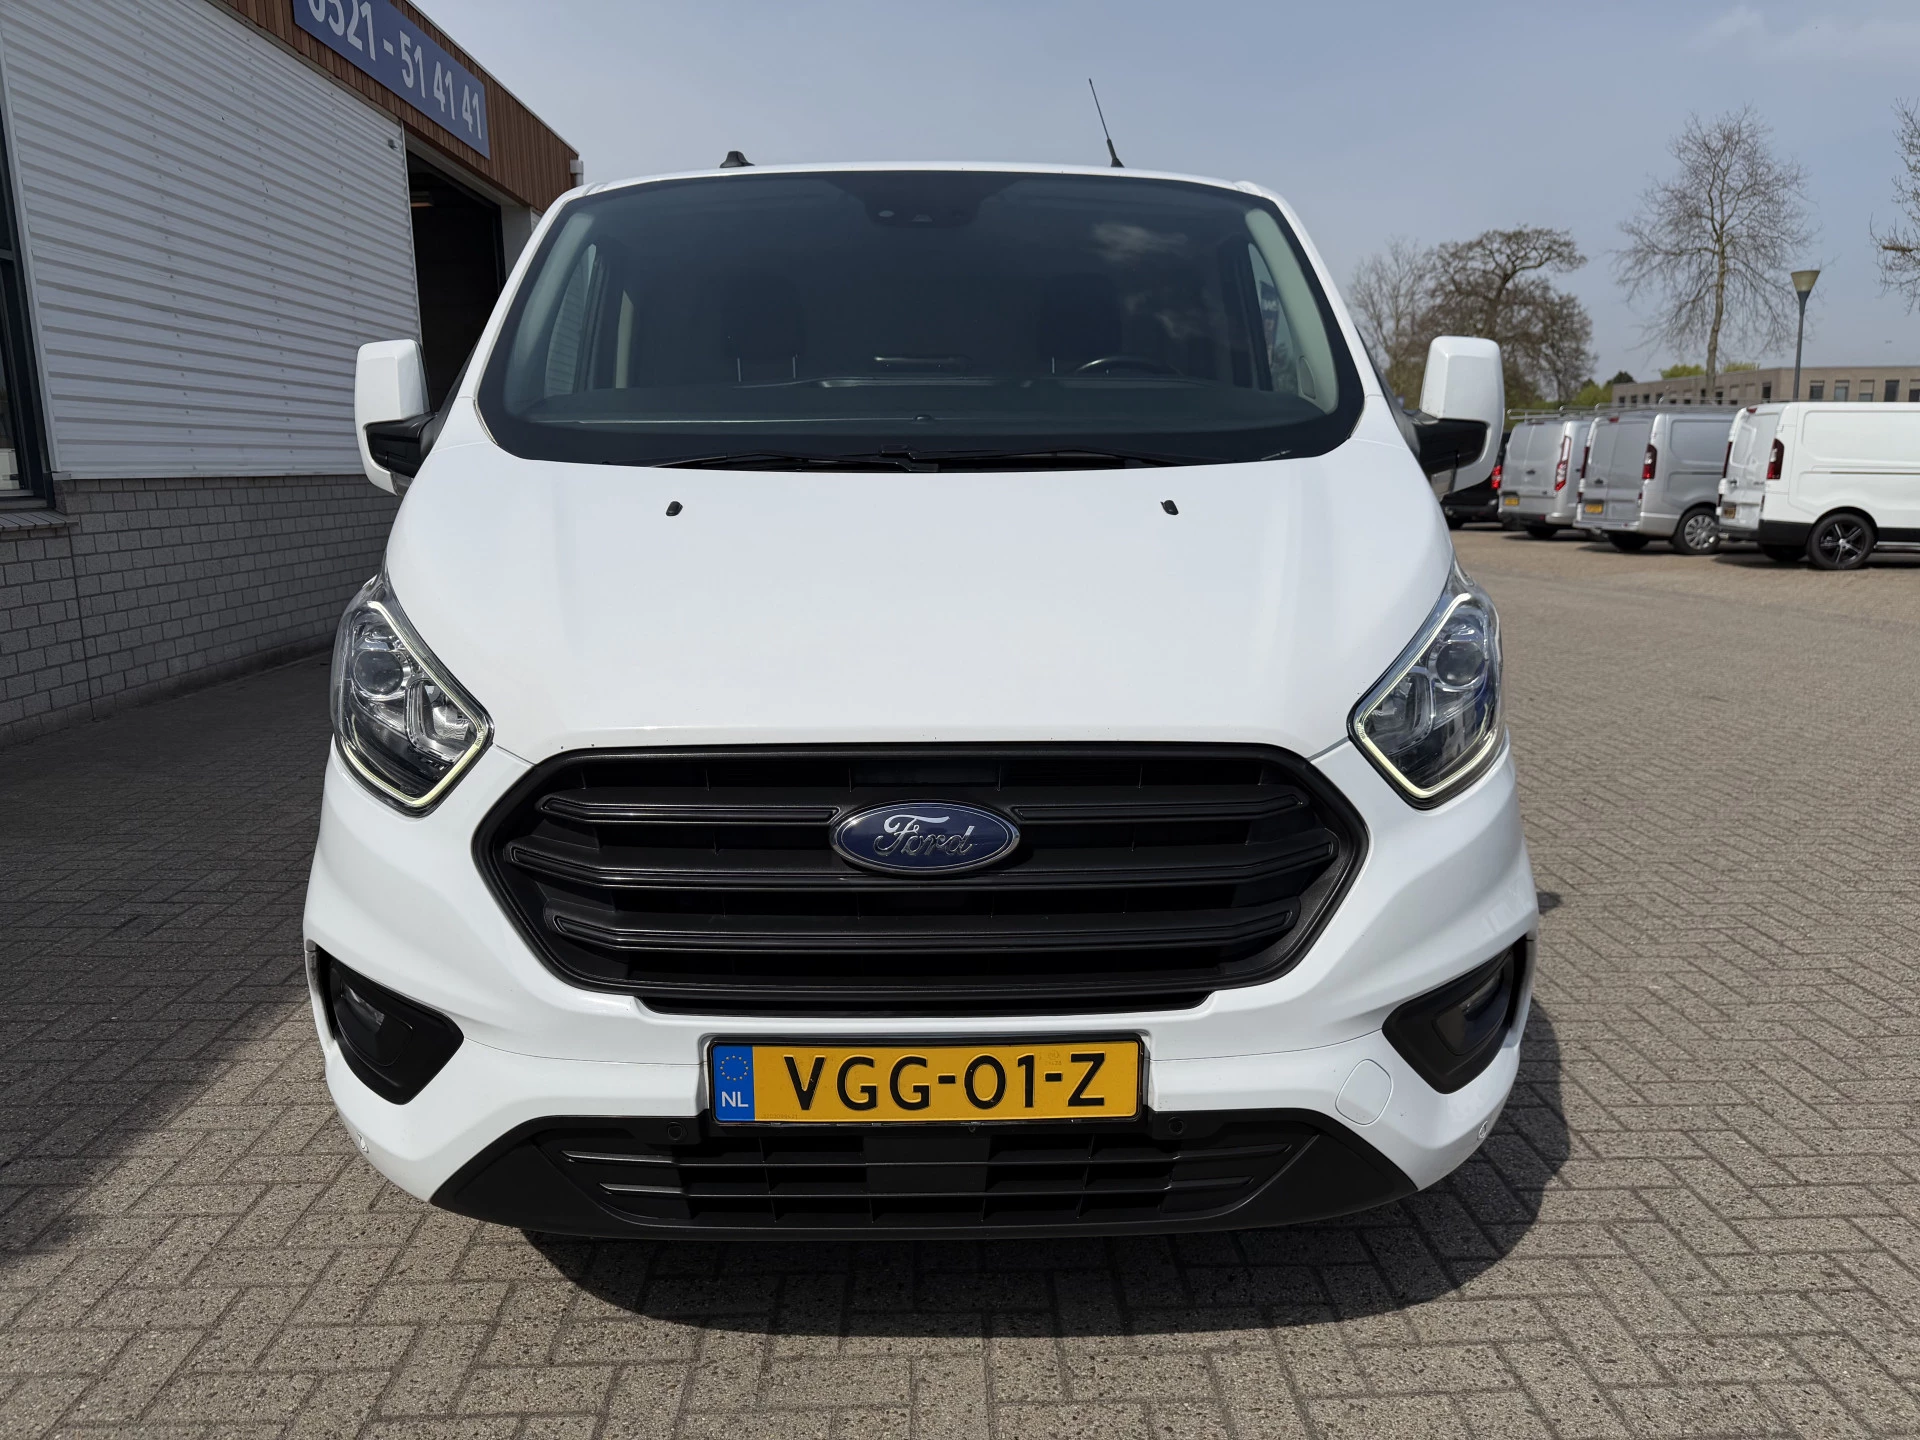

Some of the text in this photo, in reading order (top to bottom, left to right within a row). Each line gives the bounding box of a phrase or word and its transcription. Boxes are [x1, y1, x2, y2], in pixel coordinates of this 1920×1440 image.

[400, 30, 426, 99] 51
[433, 61, 456, 121] 41
[462, 84, 482, 140] 41
[873, 814, 976, 856] Ford
[721, 1091, 749, 1108] NL
[783, 1053, 1106, 1110] VGG-01-Z
